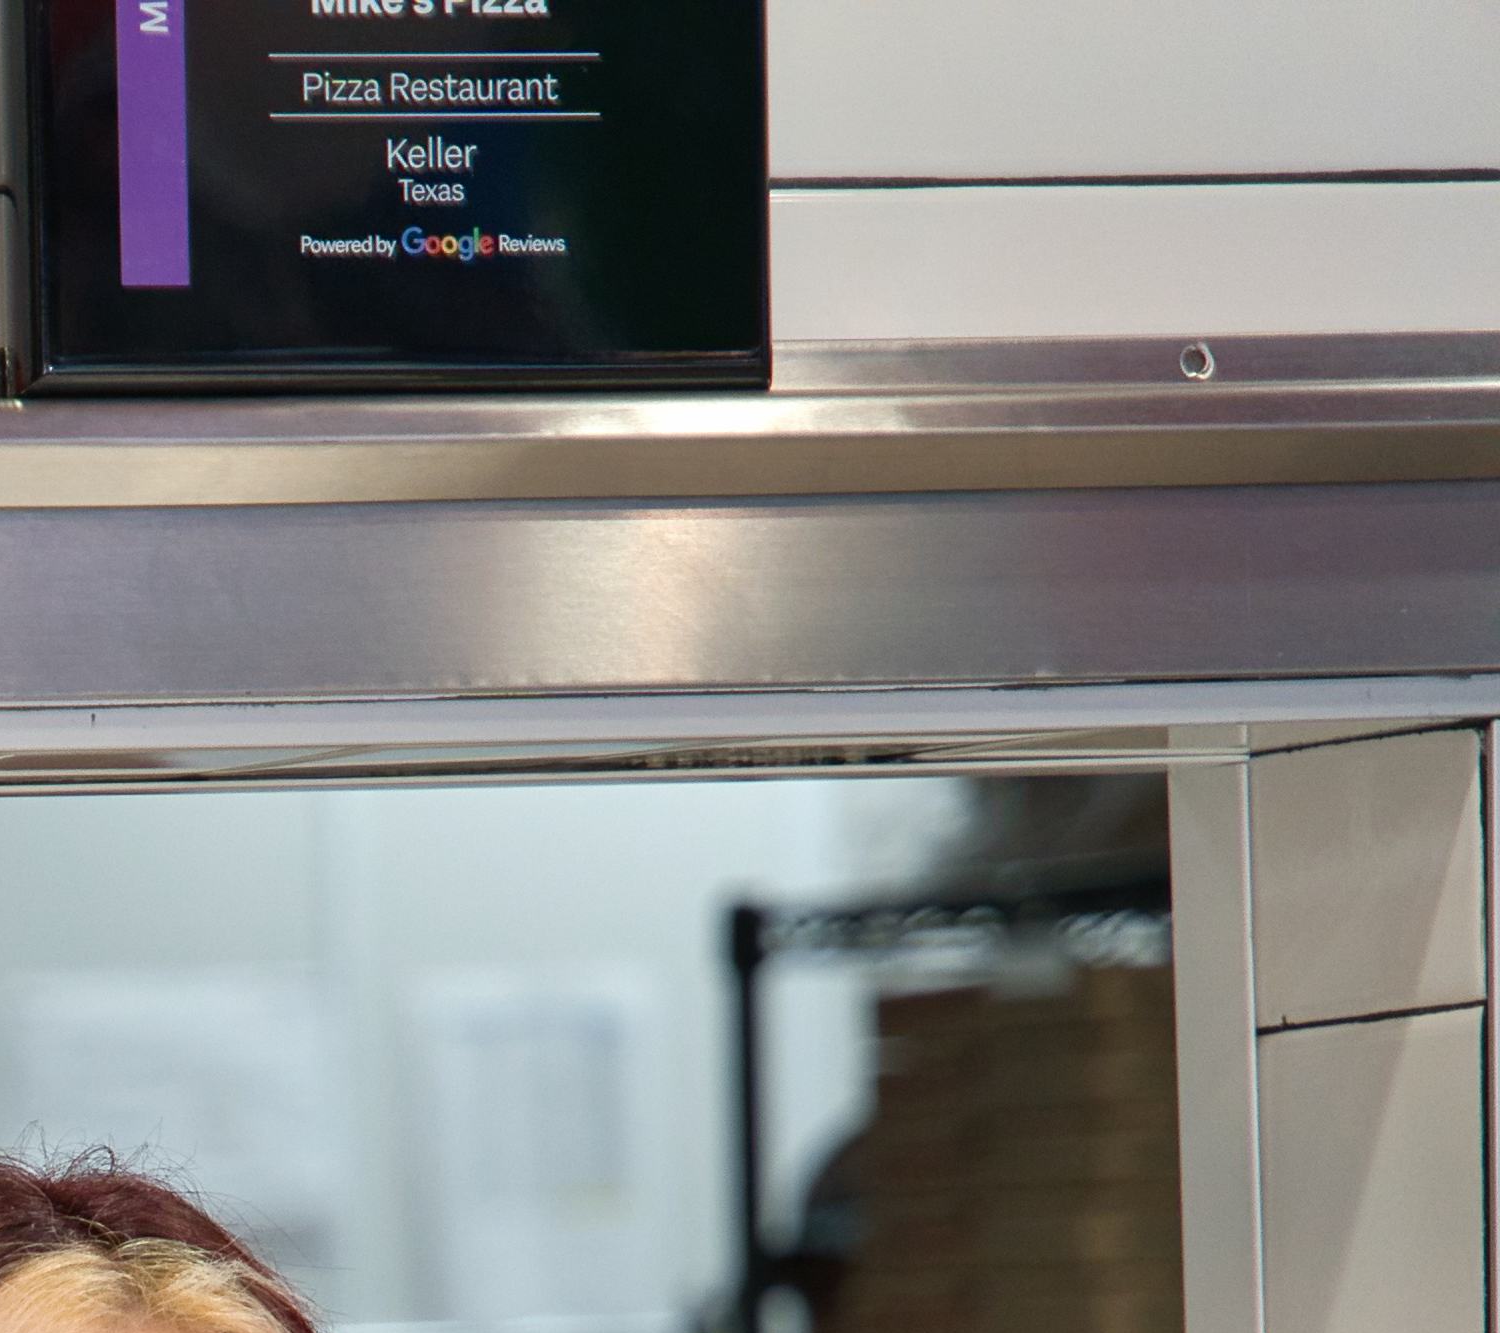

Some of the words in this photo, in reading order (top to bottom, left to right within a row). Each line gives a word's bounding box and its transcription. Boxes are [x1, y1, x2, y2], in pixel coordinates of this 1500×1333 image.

[311, 0, 435, 15] Mikes
[302, 72, 381, 102] Pizza
[390, 72, 558, 101] Restaurant
[387, 137, 477, 169] Keller
[400, 179, 464, 202] Texas
[301, 235, 373, 254] Powered
[375, 236, 396, 258] by
[402, 226, 493, 262] Google
[499, 235, 565, 252] Reviews
